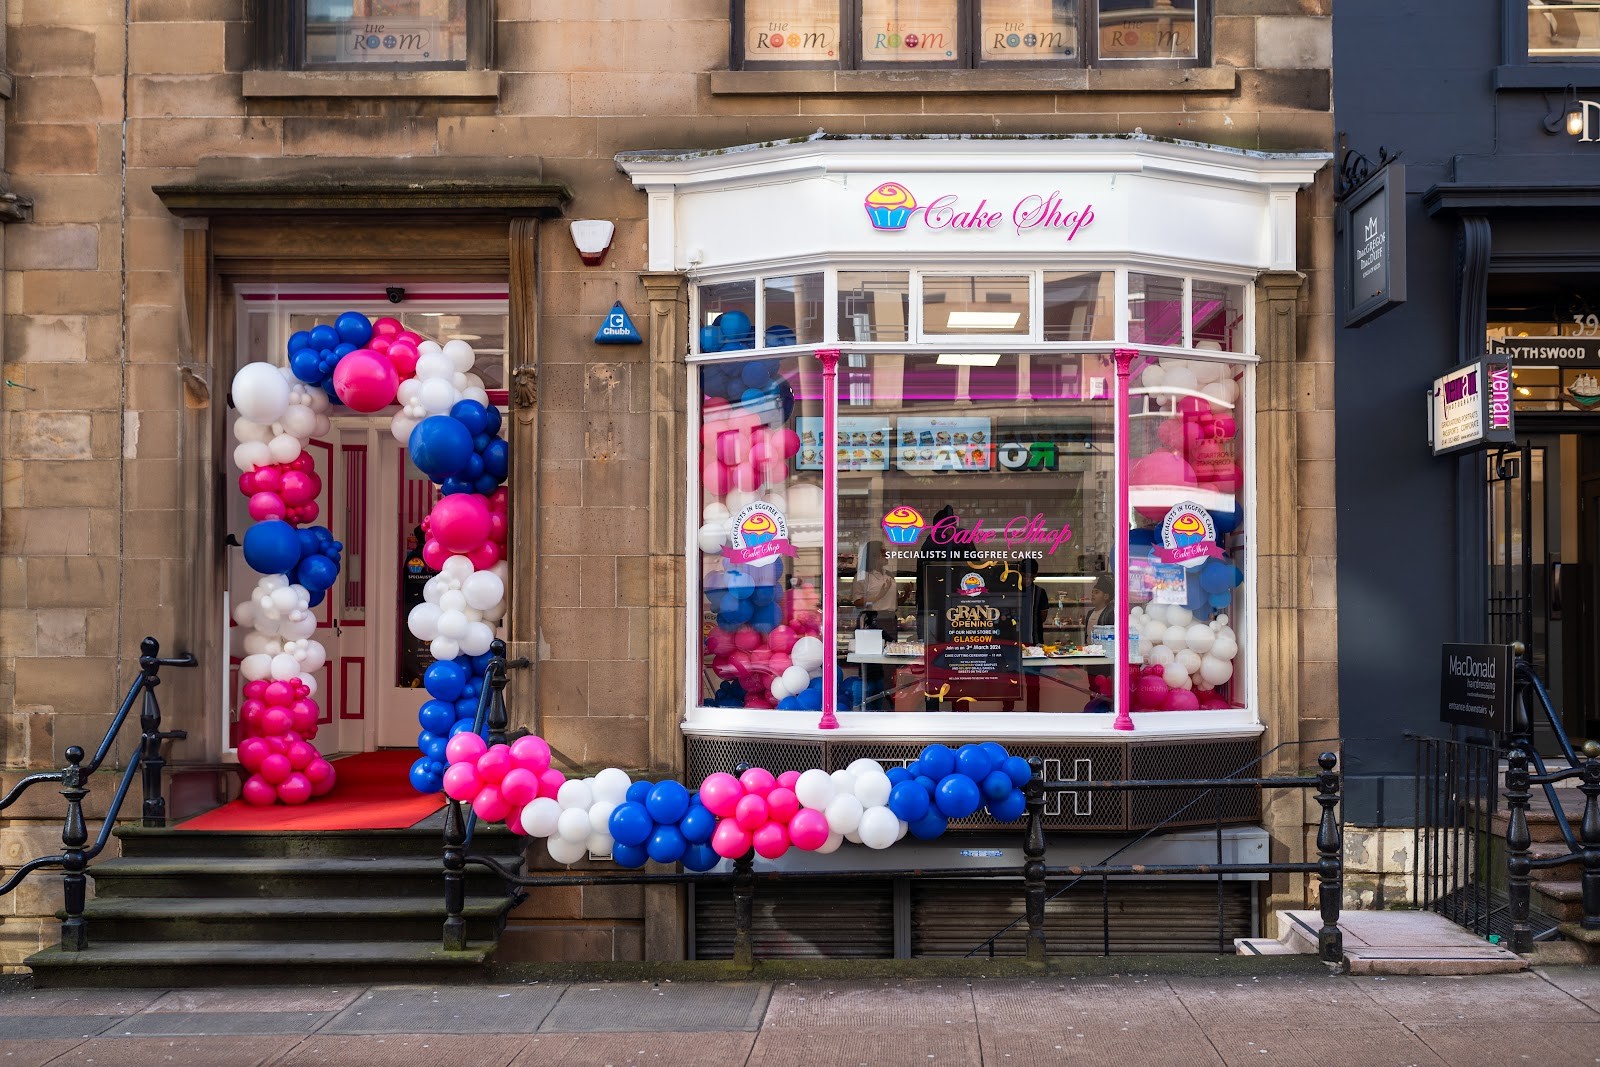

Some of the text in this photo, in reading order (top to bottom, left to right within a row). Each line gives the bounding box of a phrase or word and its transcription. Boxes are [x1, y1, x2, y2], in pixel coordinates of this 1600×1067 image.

[922, 190, 1095, 241] Cake Shop
[603, 327, 630, 335] Chubb
[1572, 313, 1599, 337] 39
[733, 511, 747, 548] SPECIALISTS
[754, 503, 778, 517] EGGFREE
[777, 516, 786, 537] CAKES
[931, 512, 1072, 555] Cake Shop
[1164, 510, 1177, 548] SPECIALISTS
[1185, 504, 1207, 519] EGGFREE
[1205, 518, 1214, 539] CAKES
[885, 550, 1044, 560] SPECIALISTS IN EGGFREE CAKES
[946, 604, 1000, 621] GRAND
[952, 620, 994, 628] OPENING
[953, 635, 993, 643] GLASGOW
[1449, 655, 1495, 678] MacDonald
[1467, 678, 1496, 693] hairdressing
[1448, 702, 1488, 715] entrance downstairs
